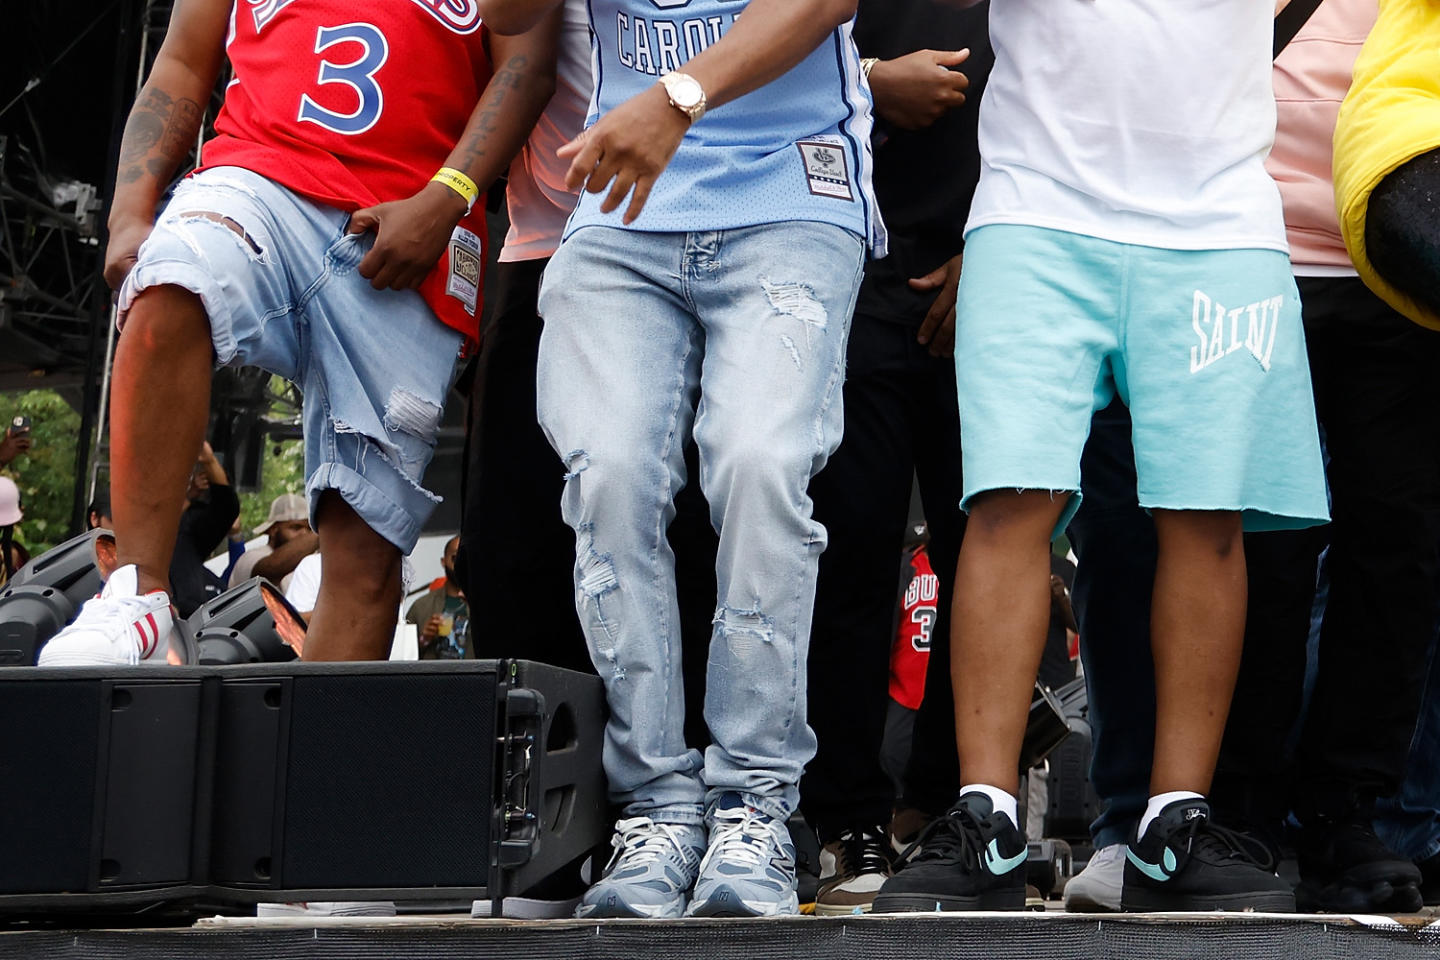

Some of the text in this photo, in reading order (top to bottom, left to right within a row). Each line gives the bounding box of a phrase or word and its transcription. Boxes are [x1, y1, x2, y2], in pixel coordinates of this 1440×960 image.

[617, 10, 742, 77] CARO
[297, 22, 390, 136] 3
[438, 172, 472, 192] PROPERTY
[1190, 289, 1284, 375] SAINT
[904, 573, 940, 611] BU
